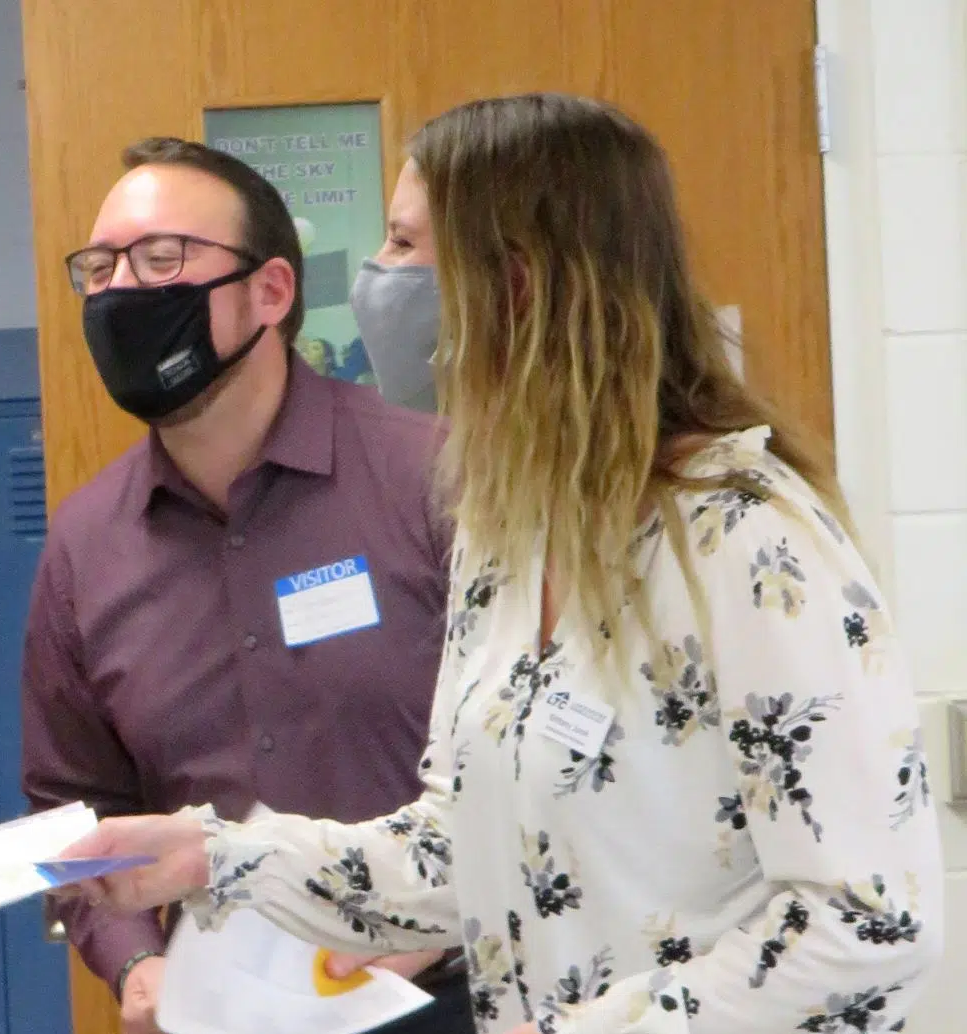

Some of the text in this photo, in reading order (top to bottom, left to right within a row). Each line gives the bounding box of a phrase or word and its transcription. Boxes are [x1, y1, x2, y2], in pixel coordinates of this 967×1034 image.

[284, 134, 330, 150] TELL
[338, 132, 367, 149] ME
[296, 162, 335, 178] SKY
[303, 189, 357, 205] LIMIT
[289, 558, 358, 592] VISITOR
